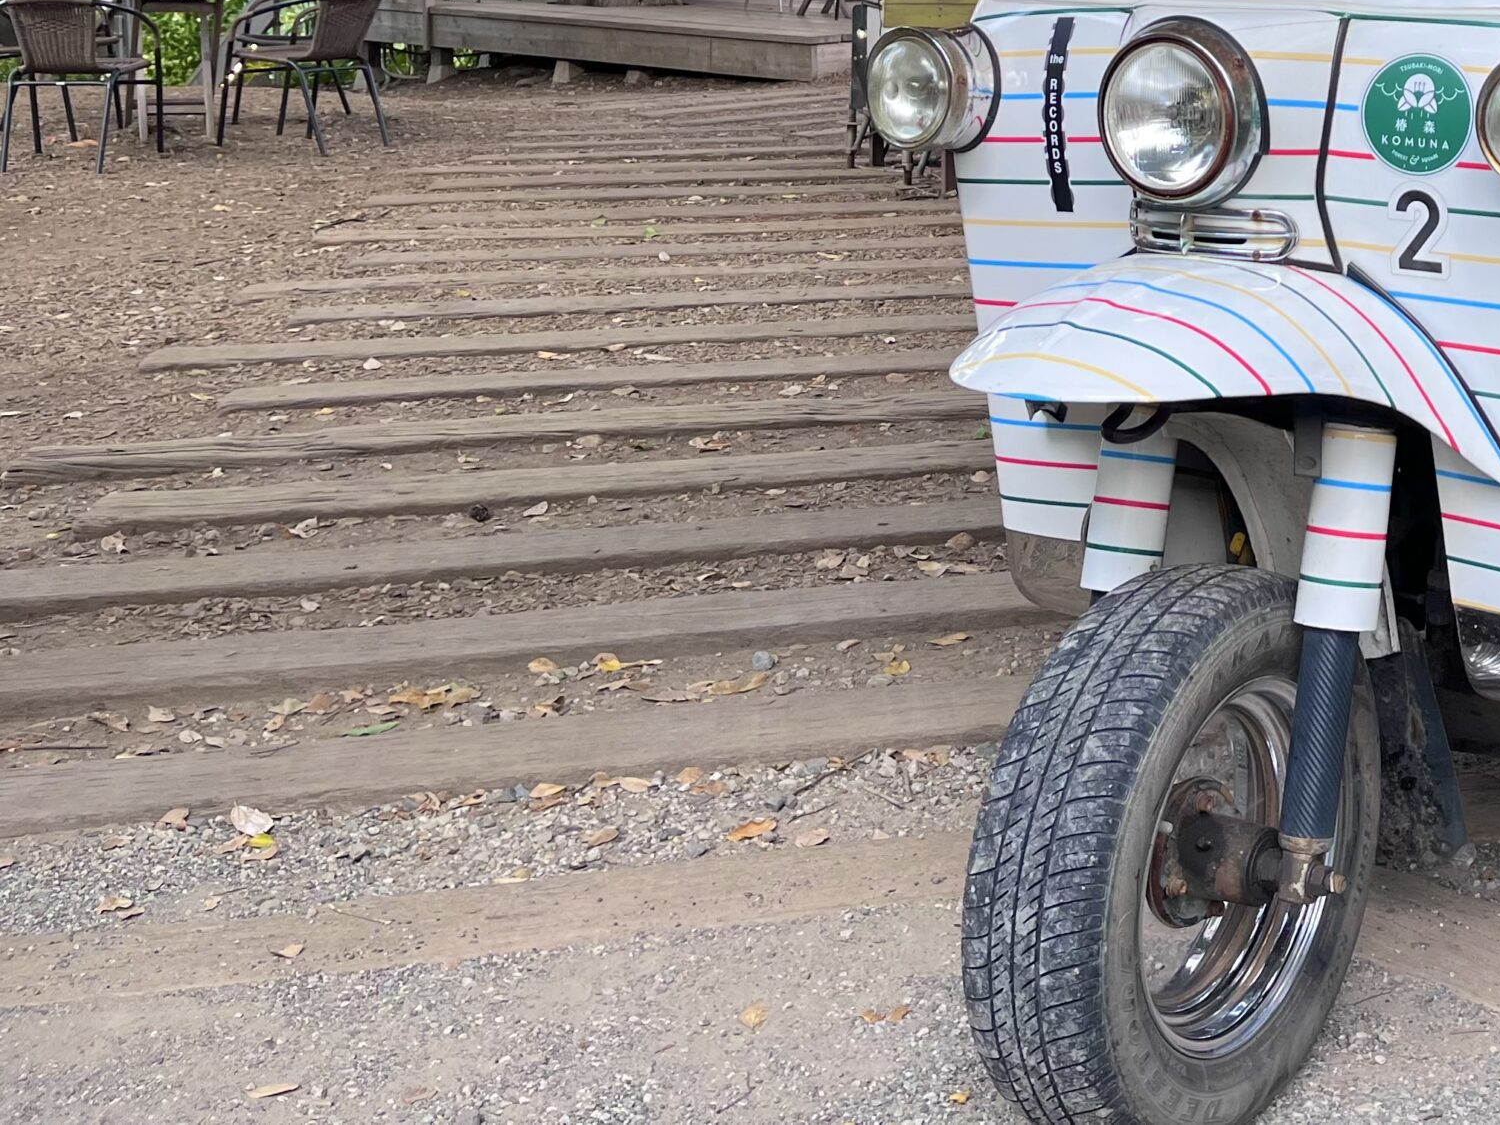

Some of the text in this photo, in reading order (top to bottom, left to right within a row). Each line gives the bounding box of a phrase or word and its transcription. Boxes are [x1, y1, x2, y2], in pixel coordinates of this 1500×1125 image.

[1400, 62, 1444, 75] TSUBAKI-MORI
[1049, 53, 1065, 174] the RECORDS
[1381, 134, 1449, 150] KOMUNA
[1396, 189, 1443, 273] 2
